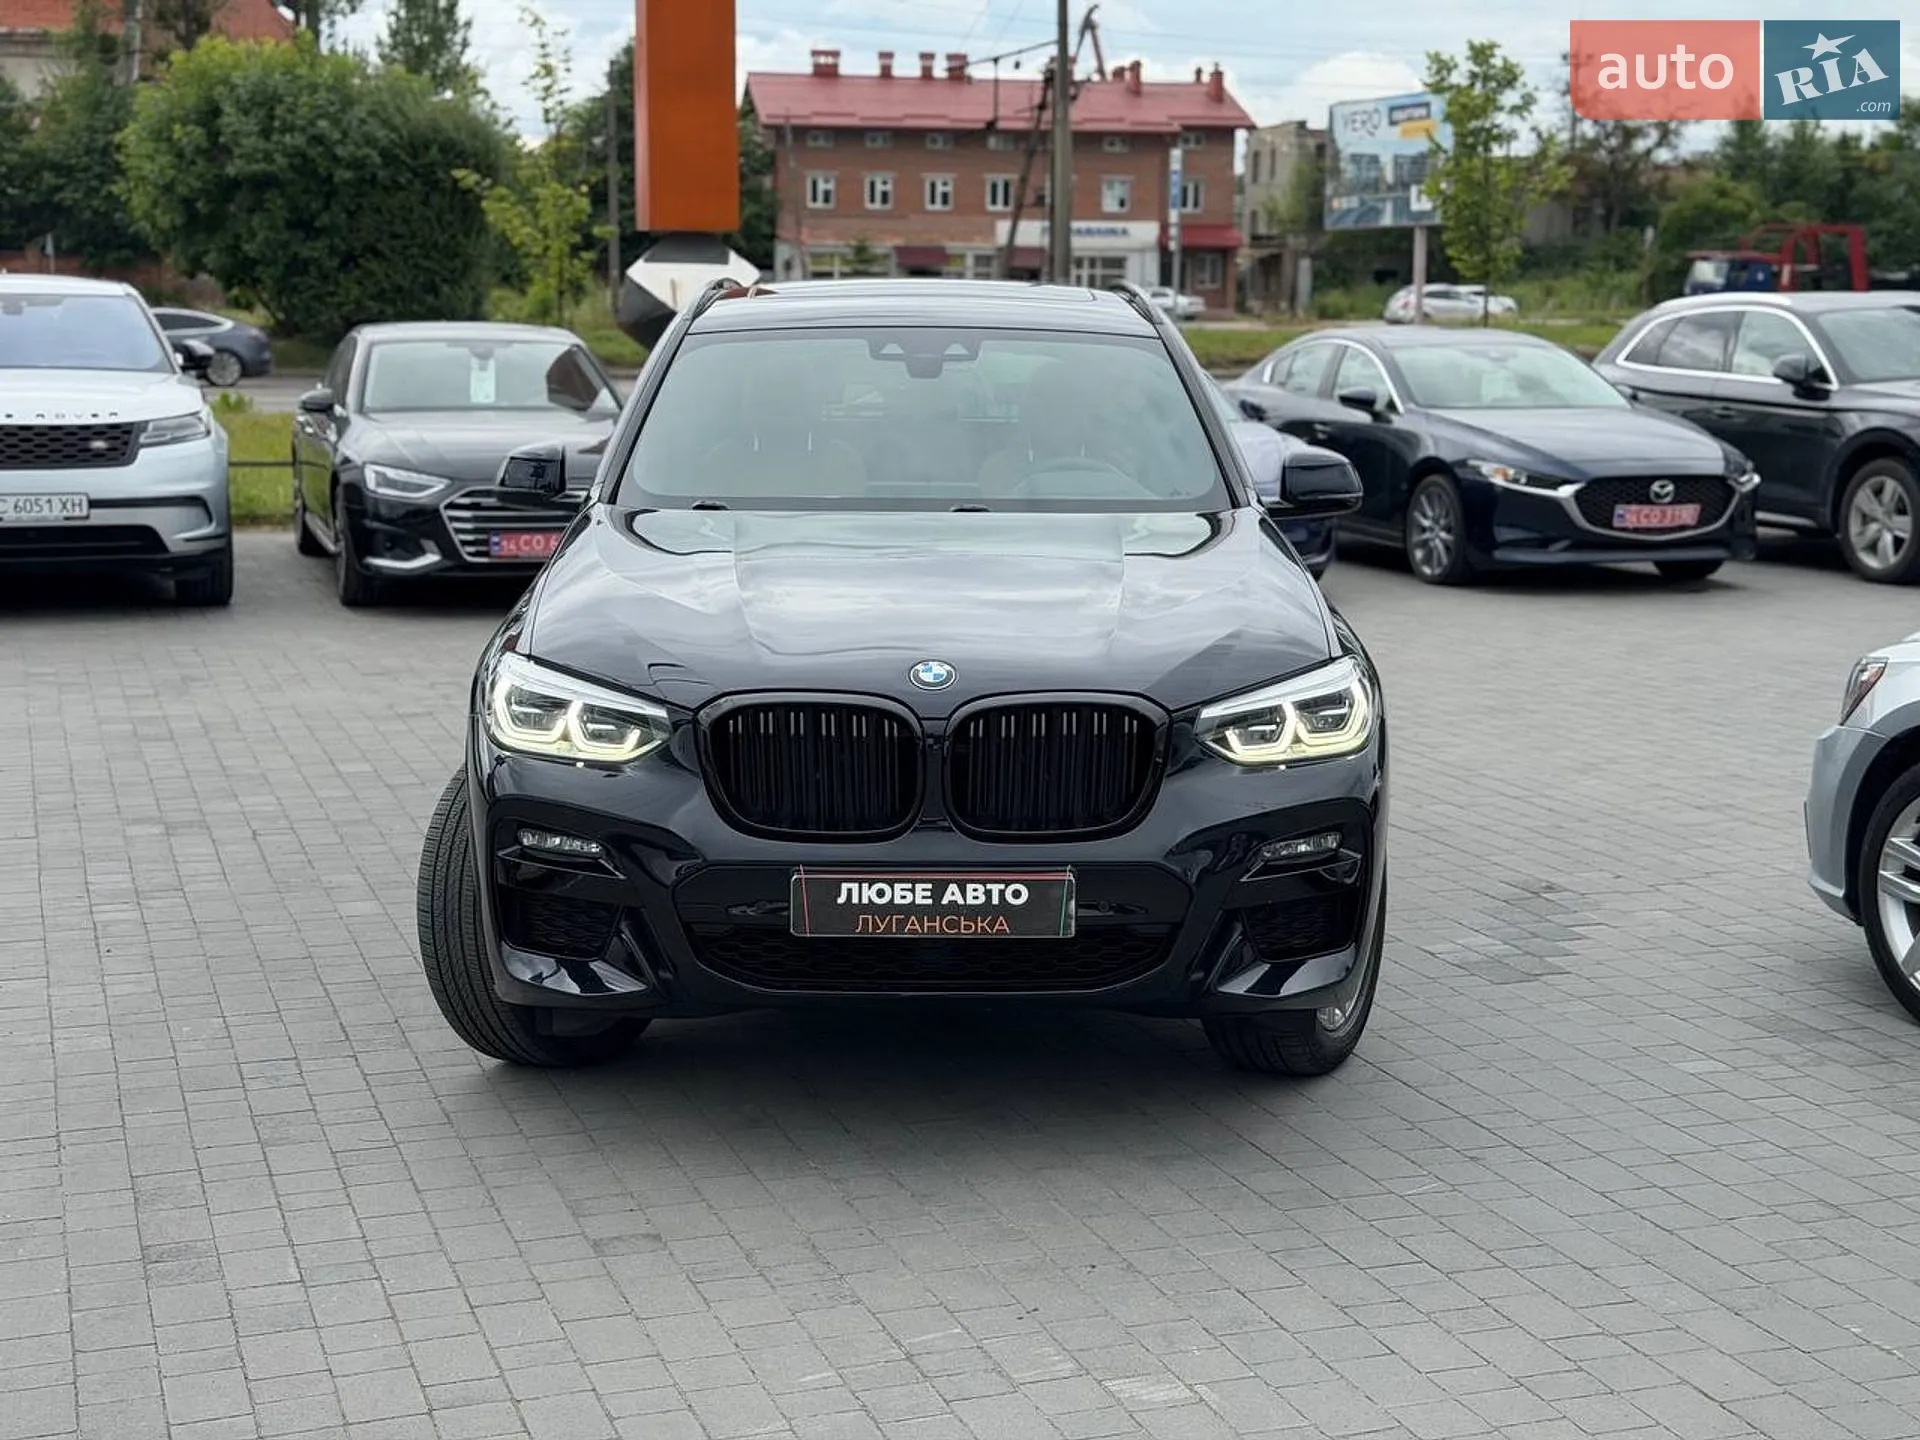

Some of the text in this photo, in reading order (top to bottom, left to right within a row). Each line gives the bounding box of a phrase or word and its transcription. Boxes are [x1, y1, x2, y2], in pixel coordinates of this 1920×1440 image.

[13, 498, 54, 514] 6051
[58, 497, 84, 514] XH
[837, 882, 1029, 906] ЛЮБЕ АВТО
[855, 915, 1010, 934] ЛУГАНСЬКА
